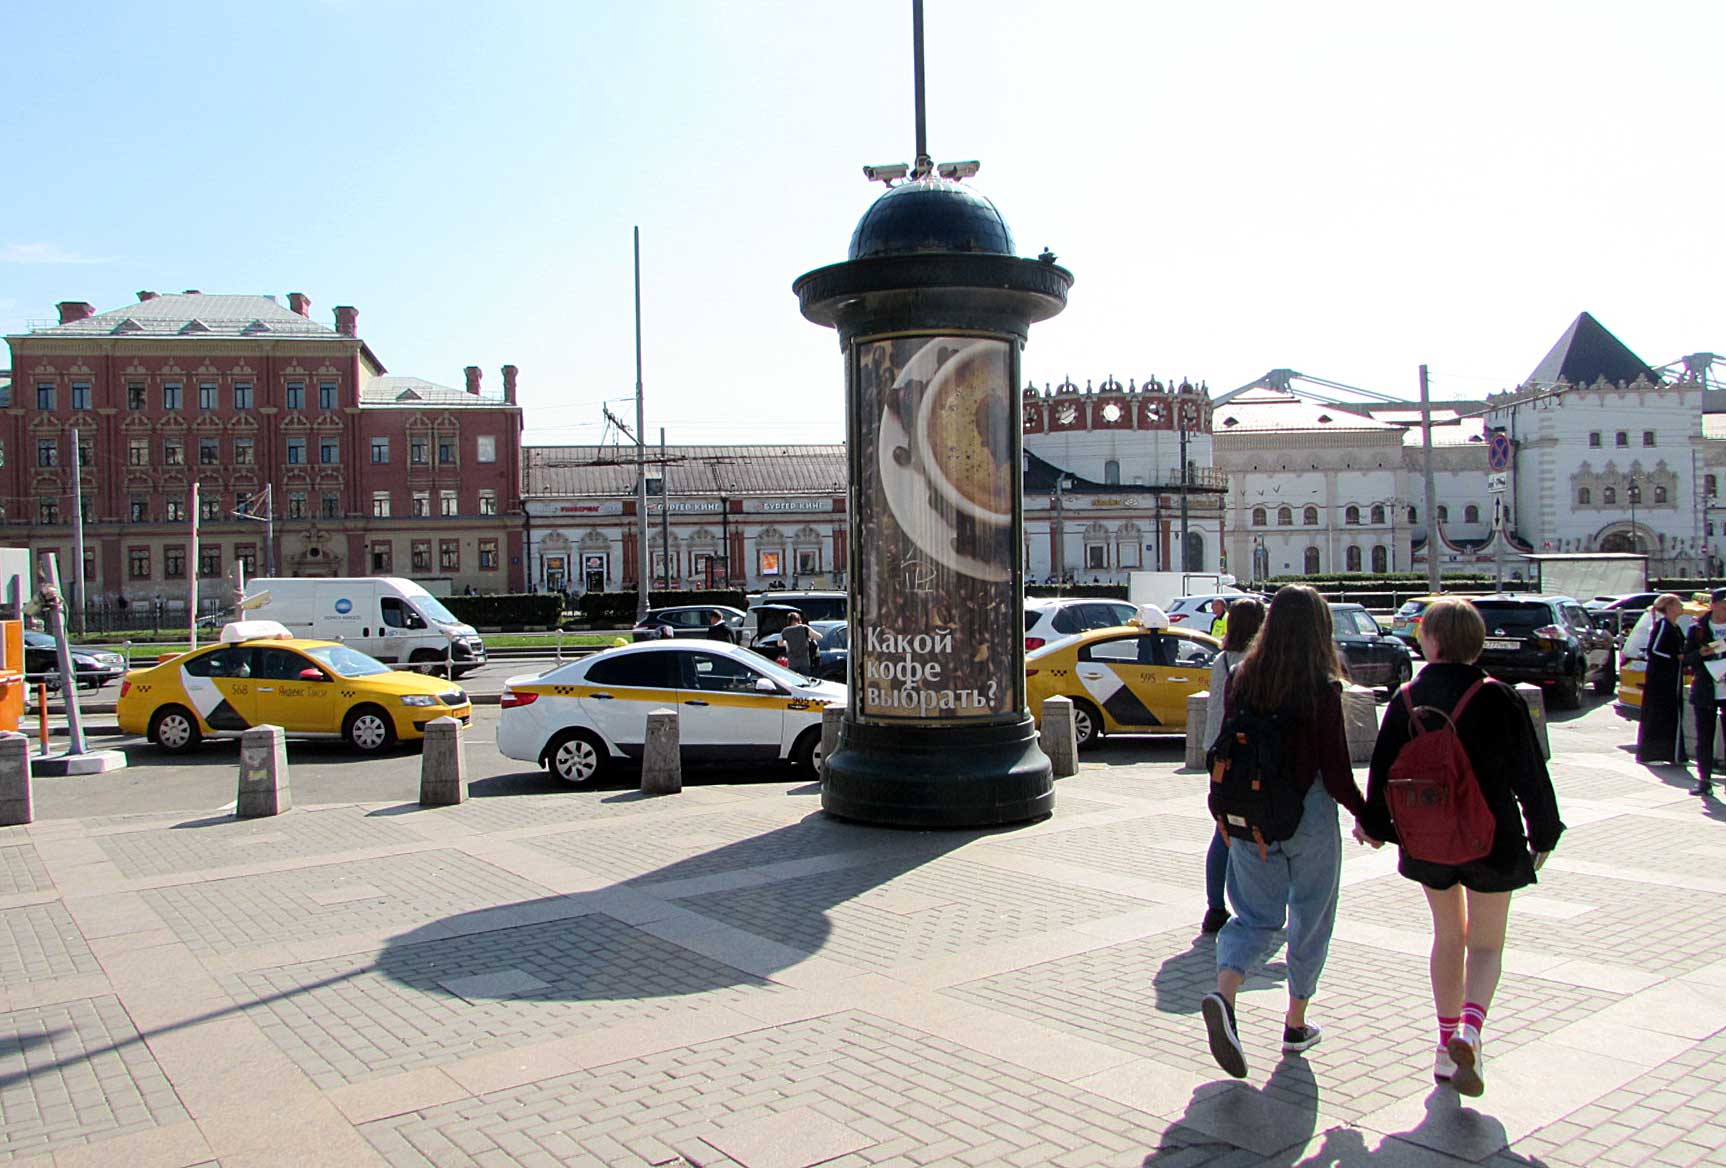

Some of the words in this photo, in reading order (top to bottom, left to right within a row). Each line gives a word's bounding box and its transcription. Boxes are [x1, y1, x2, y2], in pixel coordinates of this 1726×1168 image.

[657, 503, 692, 511] БРГЕР
[694, 503, 719, 511] КИНГ
[764, 502, 796, 510] БУРГЕР
[799, 502, 822, 510] КИНГ
[867, 626, 953, 654] Какой
[867, 653, 942, 690] кофе
[231, 683, 249, 696] 568
[278, 685, 305, 697] Яндекс
[307, 686, 328, 697] Такси
[792, 696, 809, 705] 905
[868, 680, 998, 718] выбрать?
